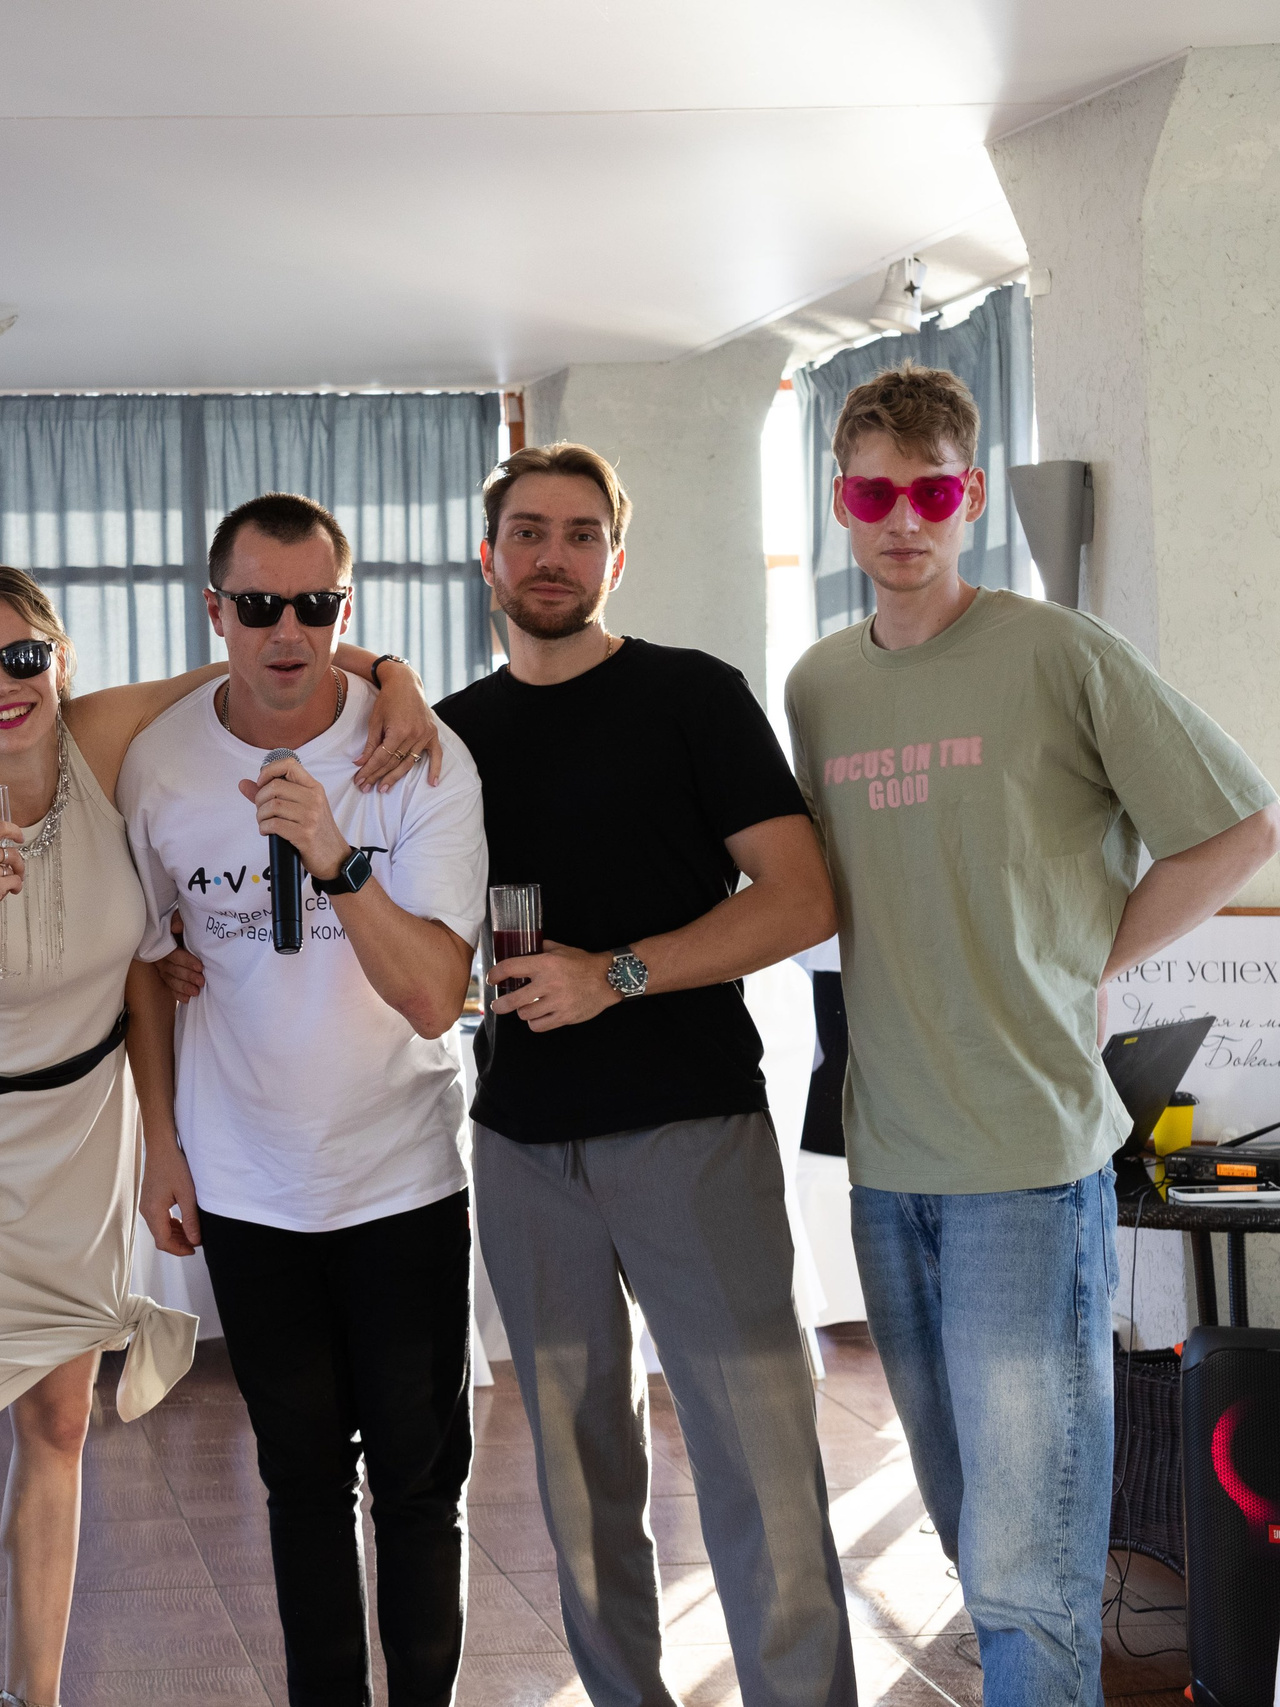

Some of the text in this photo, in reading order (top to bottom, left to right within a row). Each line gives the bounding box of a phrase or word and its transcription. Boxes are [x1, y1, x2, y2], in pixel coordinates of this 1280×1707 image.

[824, 736, 983, 785] FOCUS ON THE
[868, 774, 929, 810] GOOD
[311, 926, 346, 939] ком
